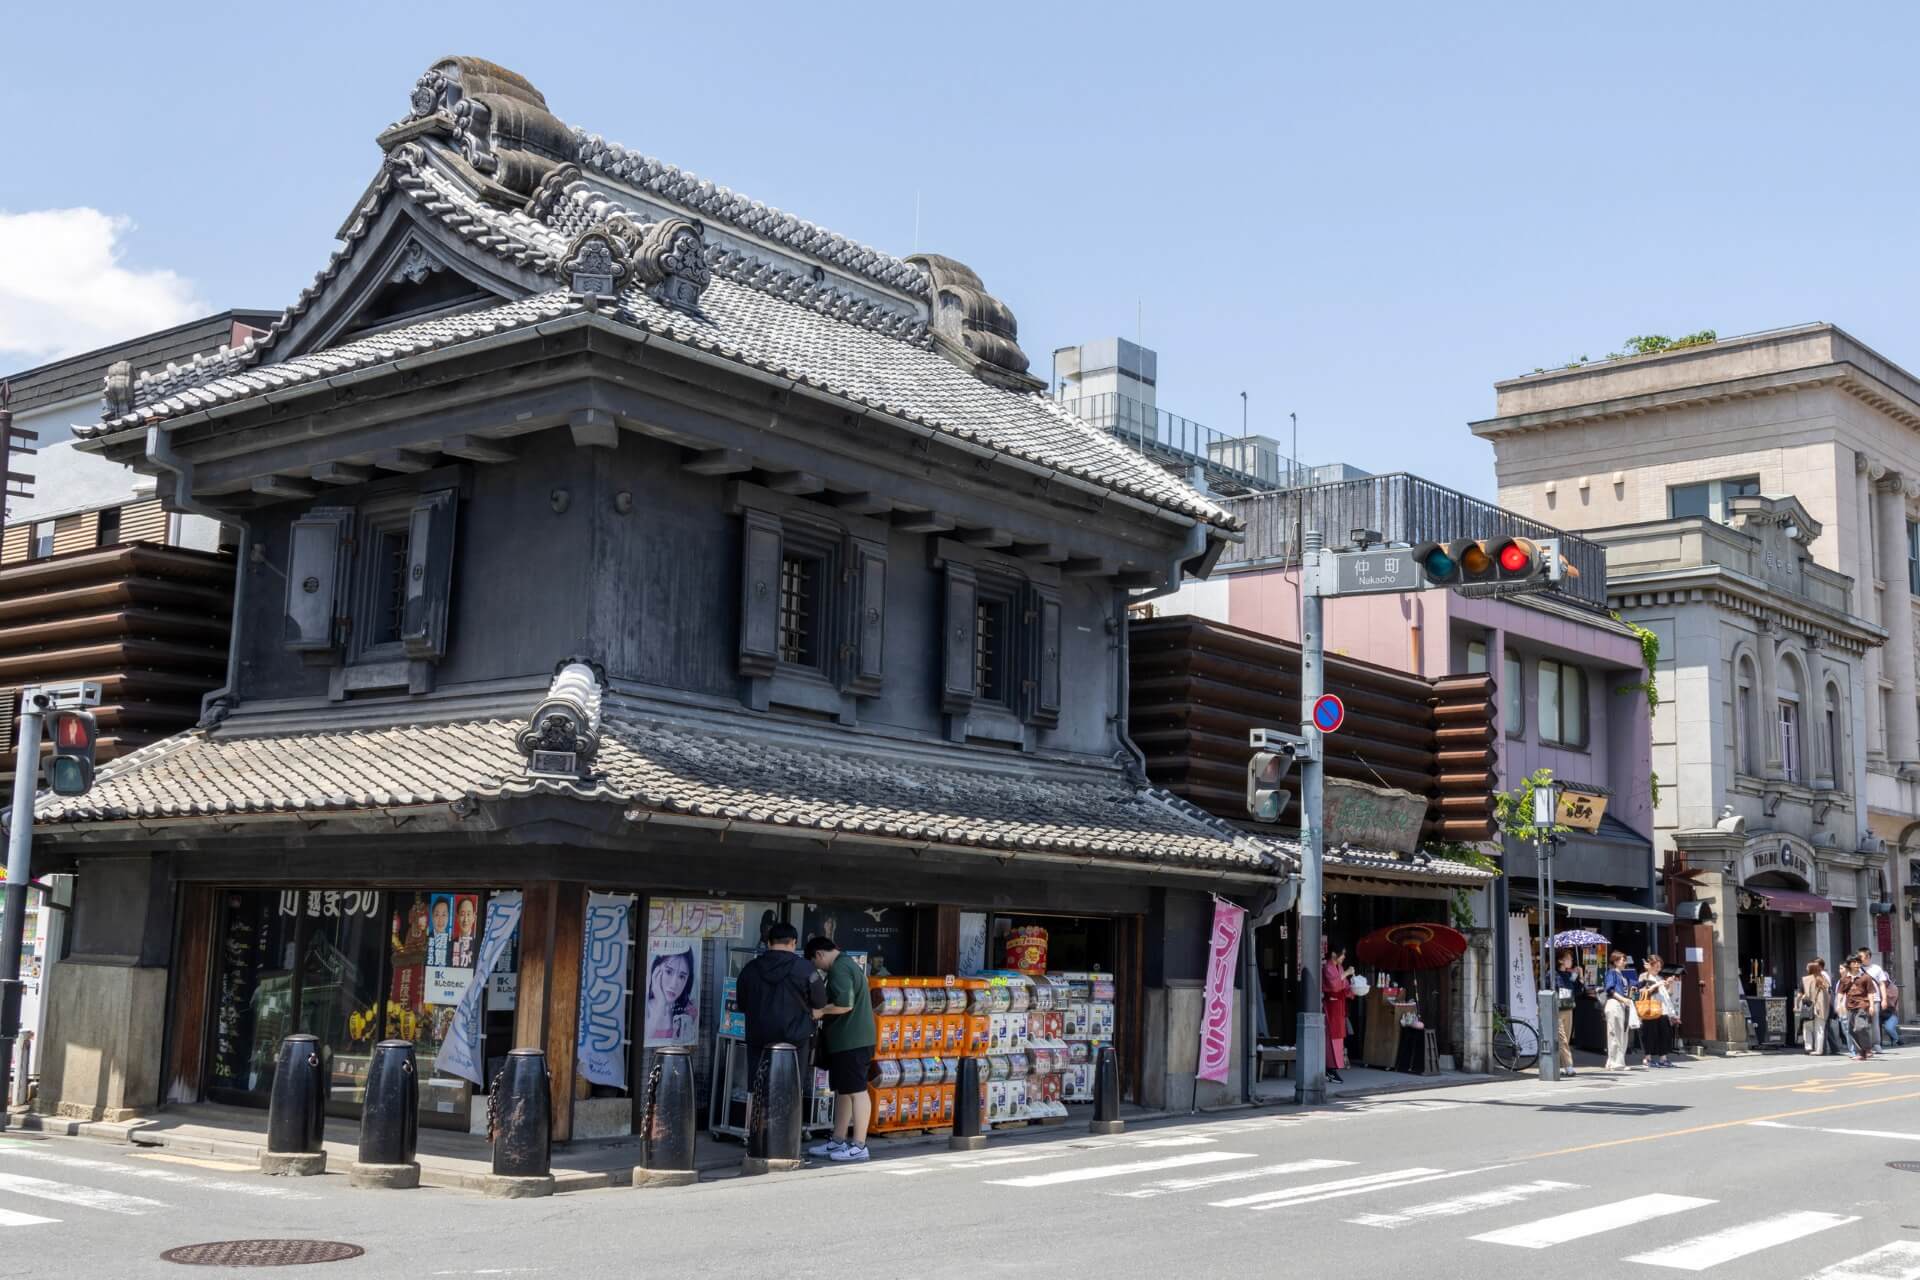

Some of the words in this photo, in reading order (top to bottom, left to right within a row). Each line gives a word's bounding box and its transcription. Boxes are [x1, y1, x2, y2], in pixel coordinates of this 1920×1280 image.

[1355, 558, 1399, 576] 仲町
[1359, 575, 1396, 585] Nakacho
[460, 935, 473, 967] すが
[587, 904, 627, 1053] プリクラ
[1206, 923, 1237, 1067] プリクラ
